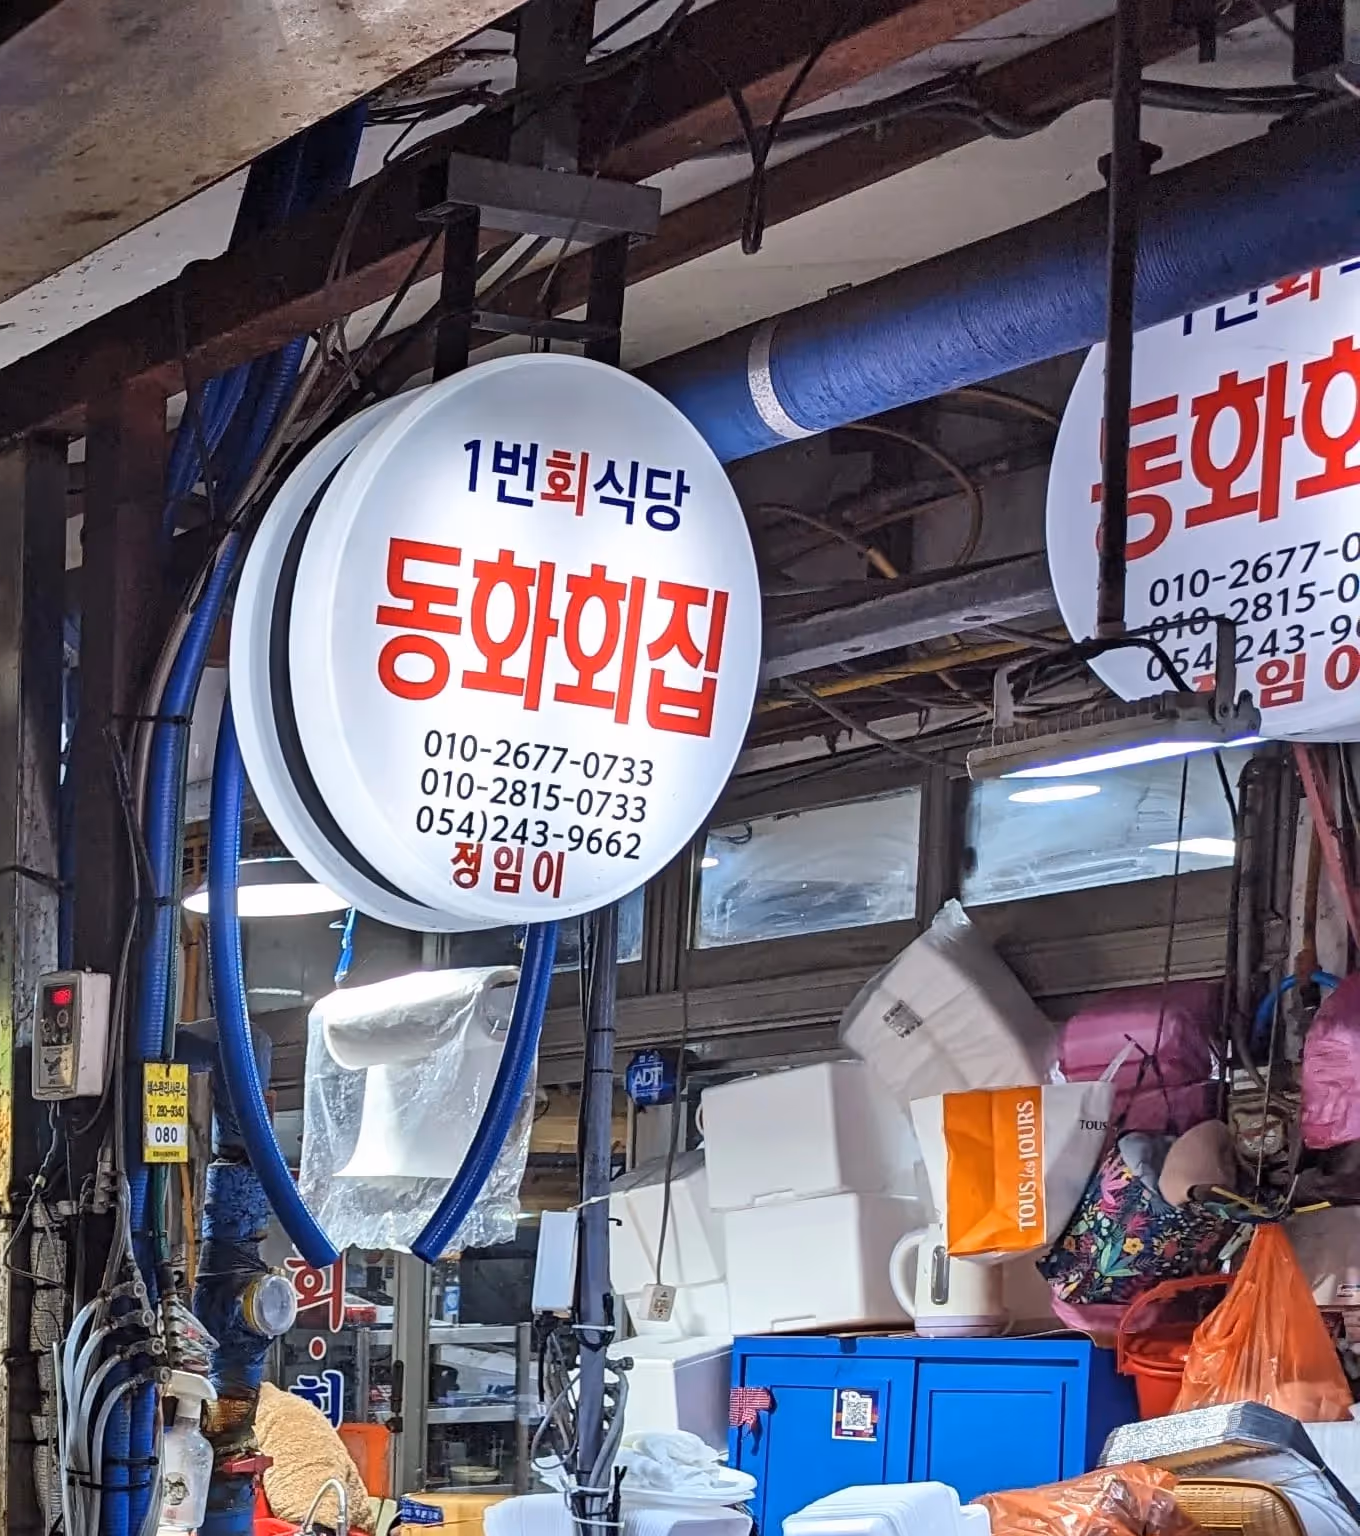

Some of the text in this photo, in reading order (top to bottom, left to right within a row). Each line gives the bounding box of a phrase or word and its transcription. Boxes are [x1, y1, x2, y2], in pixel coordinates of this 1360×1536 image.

[463, 439, 691, 532] 1번회식당
[376, 537, 730, 740] 동화회집
[1147, 614, 1360, 682] 054243-9
[423, 730, 655, 788] 010-2677-0733
[420, 767, 648, 824] 010-2815-0733
[415, 806, 643, 861] 054)243-9662
[155, 1126, 178, 1143] 080
[1017, 1100, 1039, 1160] JOURS
[1018, 1181, 1037, 1232] TOUS
